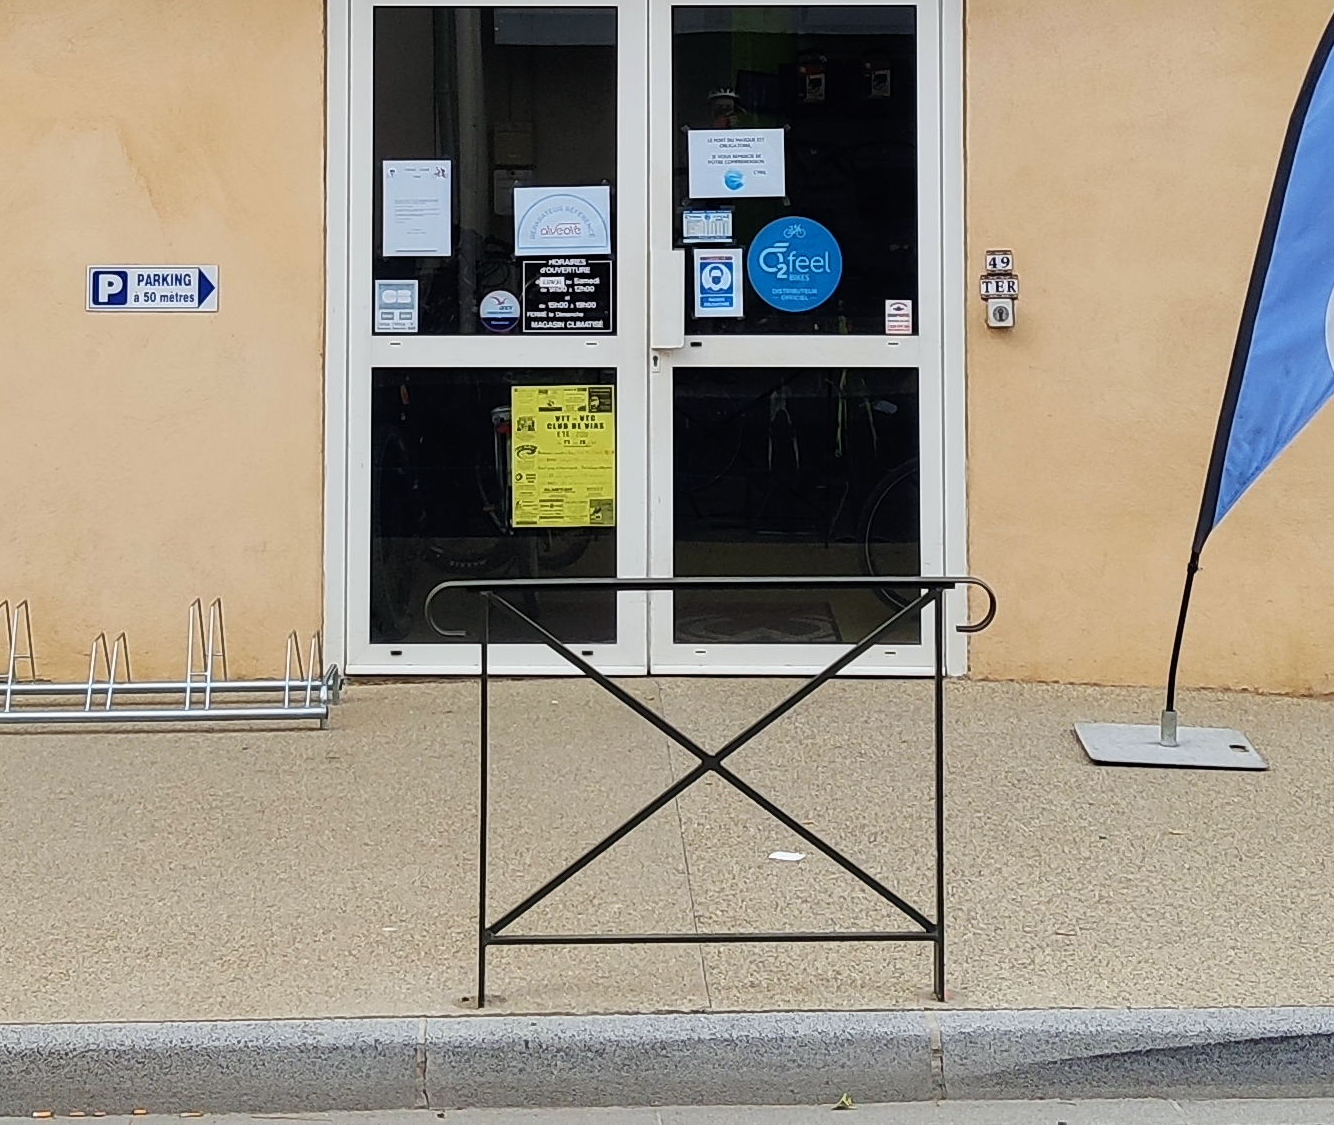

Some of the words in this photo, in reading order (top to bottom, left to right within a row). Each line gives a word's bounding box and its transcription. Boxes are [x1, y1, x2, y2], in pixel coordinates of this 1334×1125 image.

[988, 256, 1010, 268] 49
[137, 273, 192, 286] PARKING
[982, 280, 1016, 293] TER
[134, 291, 139, 302] à
[143, 291, 156, 303] 50
[160, 290, 195, 303] mètres
